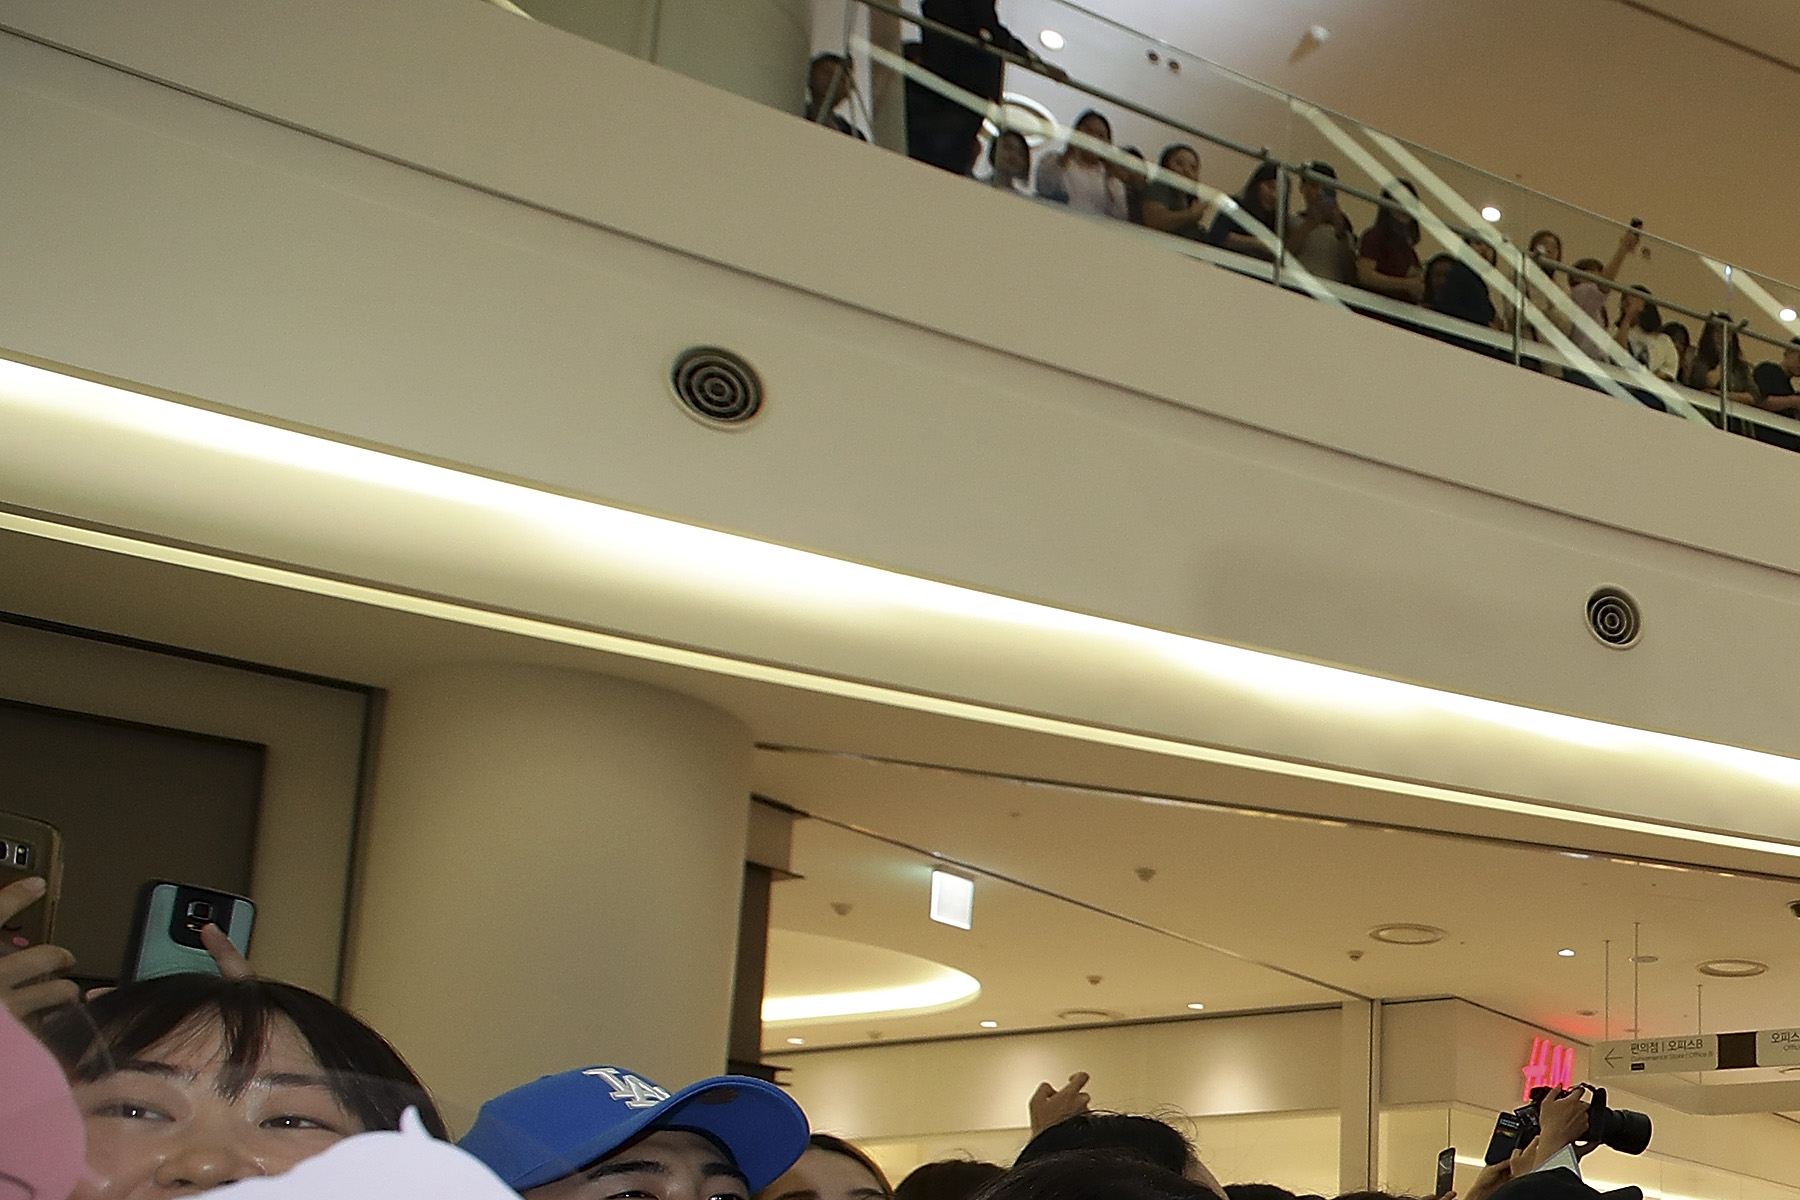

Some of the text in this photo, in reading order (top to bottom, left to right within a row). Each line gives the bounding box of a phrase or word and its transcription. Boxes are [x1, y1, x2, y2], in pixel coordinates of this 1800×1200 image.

[1631, 1039, 1703, 1055] 편의점 오피스B
[582, 1067, 671, 1110] LA
